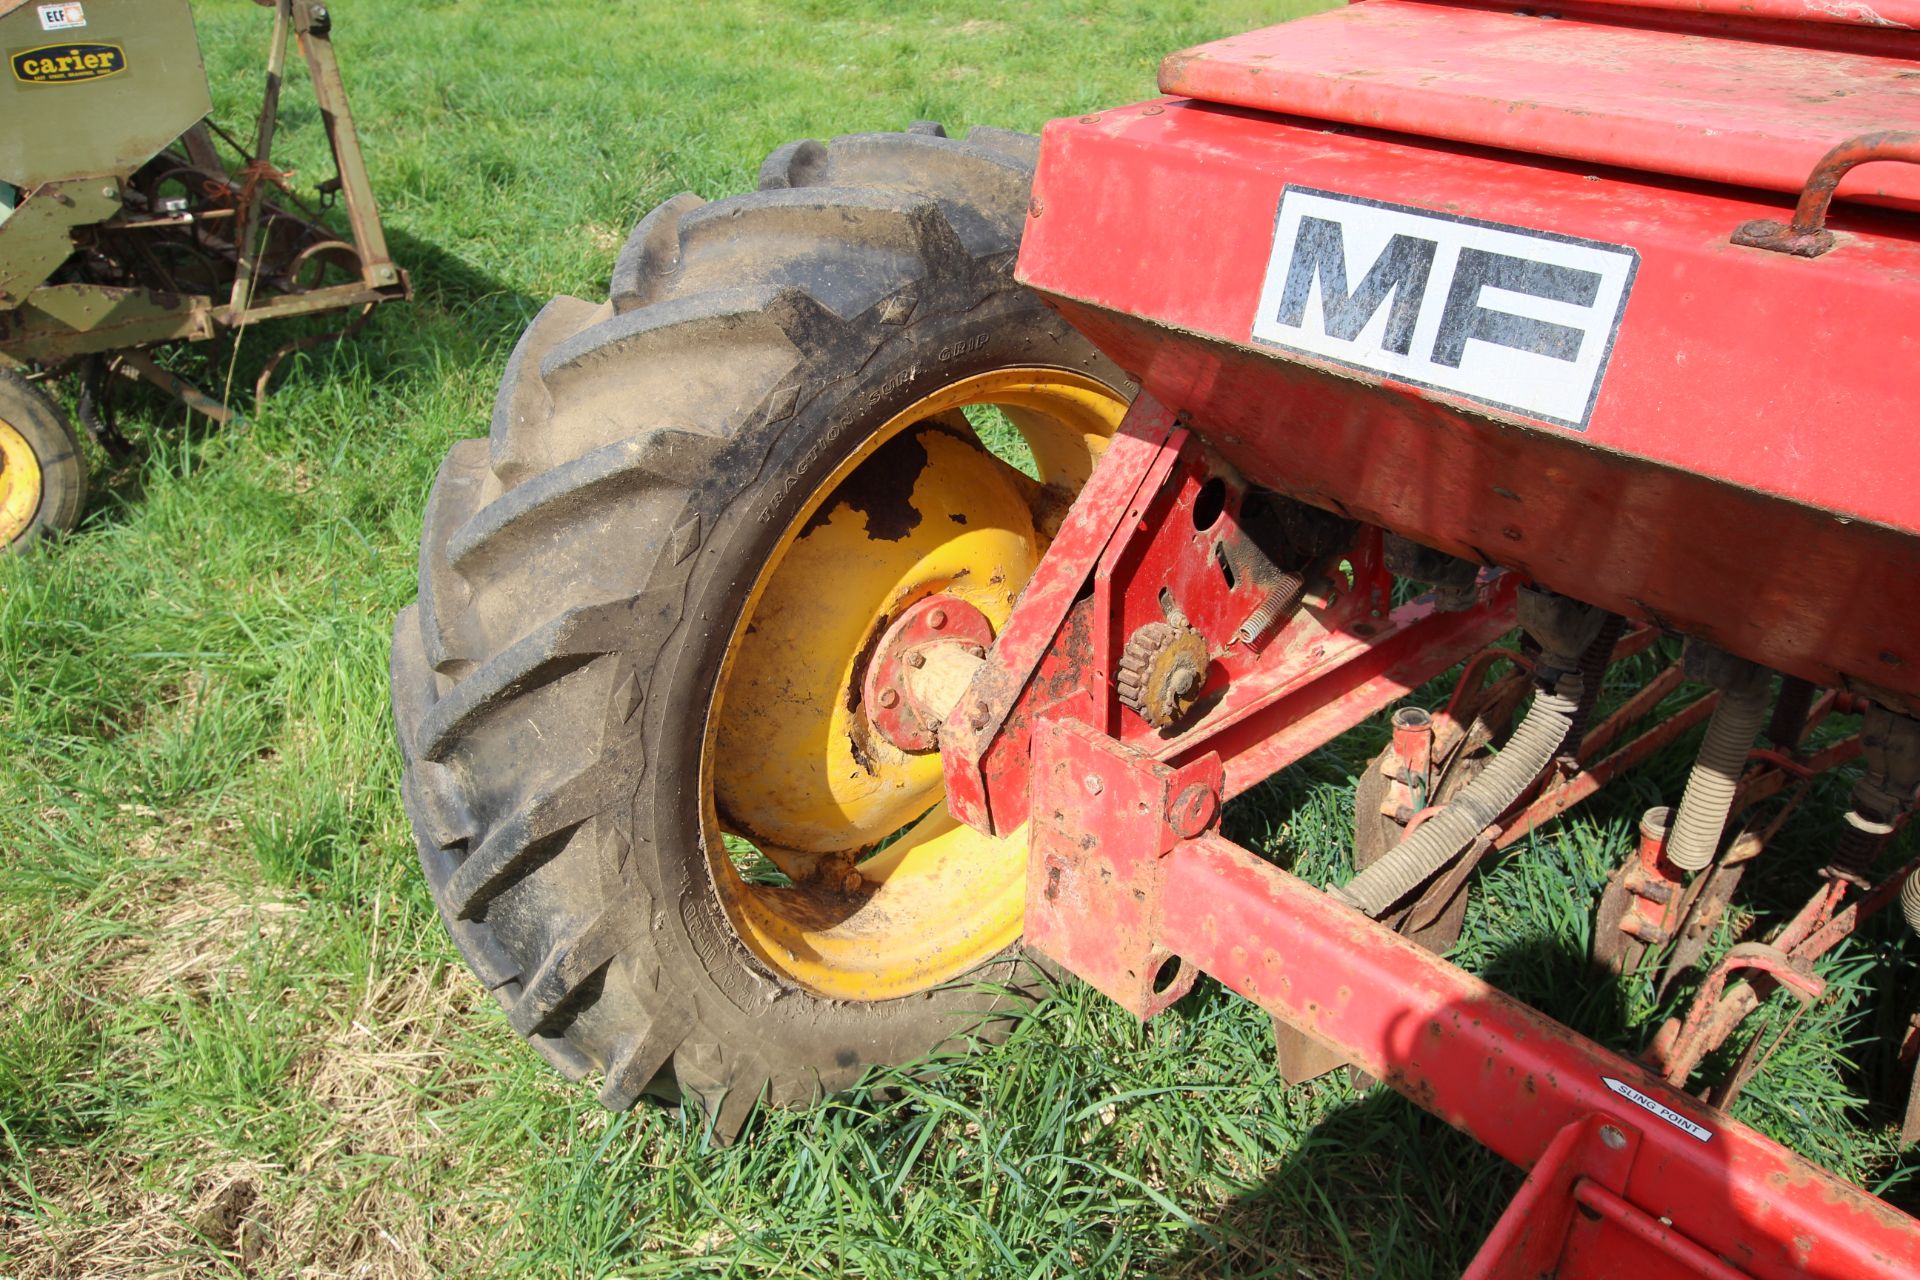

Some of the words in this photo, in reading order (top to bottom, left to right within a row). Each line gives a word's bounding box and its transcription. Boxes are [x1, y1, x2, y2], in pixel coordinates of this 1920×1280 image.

[23, 49, 115, 75] carier
[1276, 215, 1603, 369] MF
[757, 411, 854, 525] TRACTION
[868, 360, 922, 406] SURE
[938, 332, 991, 362] GRIP
[1618, 1085, 1657, 1110] SLING
[1660, 1108, 1700, 1133] POINT
